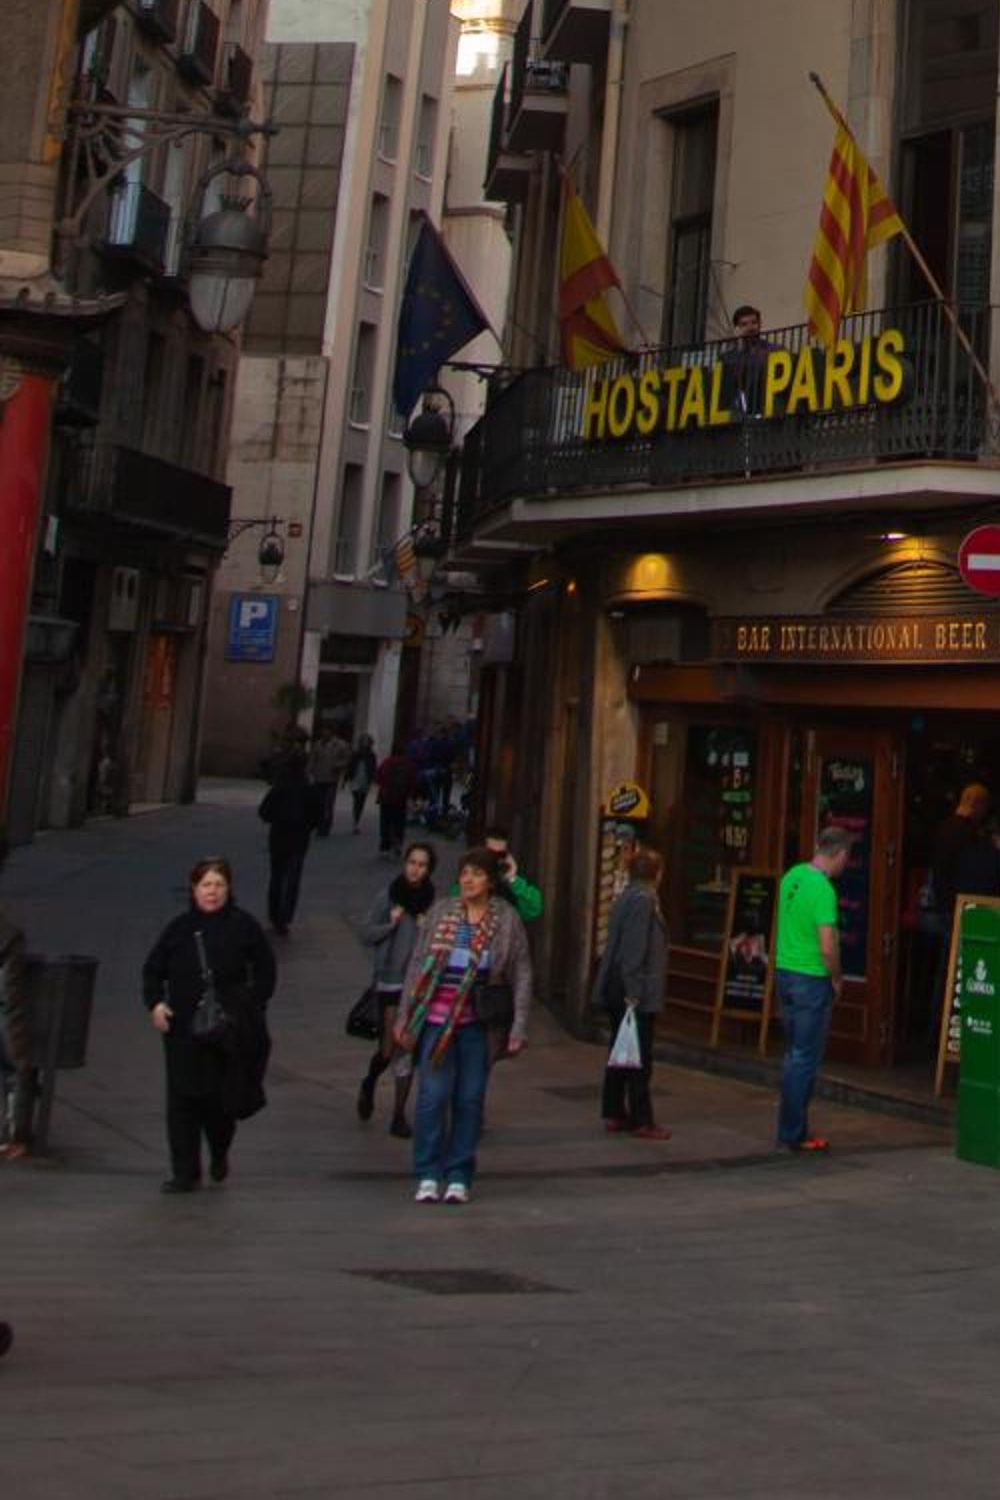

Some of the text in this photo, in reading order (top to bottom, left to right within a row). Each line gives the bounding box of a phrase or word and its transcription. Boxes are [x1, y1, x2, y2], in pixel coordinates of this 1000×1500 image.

[583, 329, 905, 439] HOSTAL PARIS
[240, 601, 268, 629] P
[737, 626, 770, 651] BAR
[780, 623, 923, 651] INTERNATIONAL
[935, 622, 987, 650] BEER
